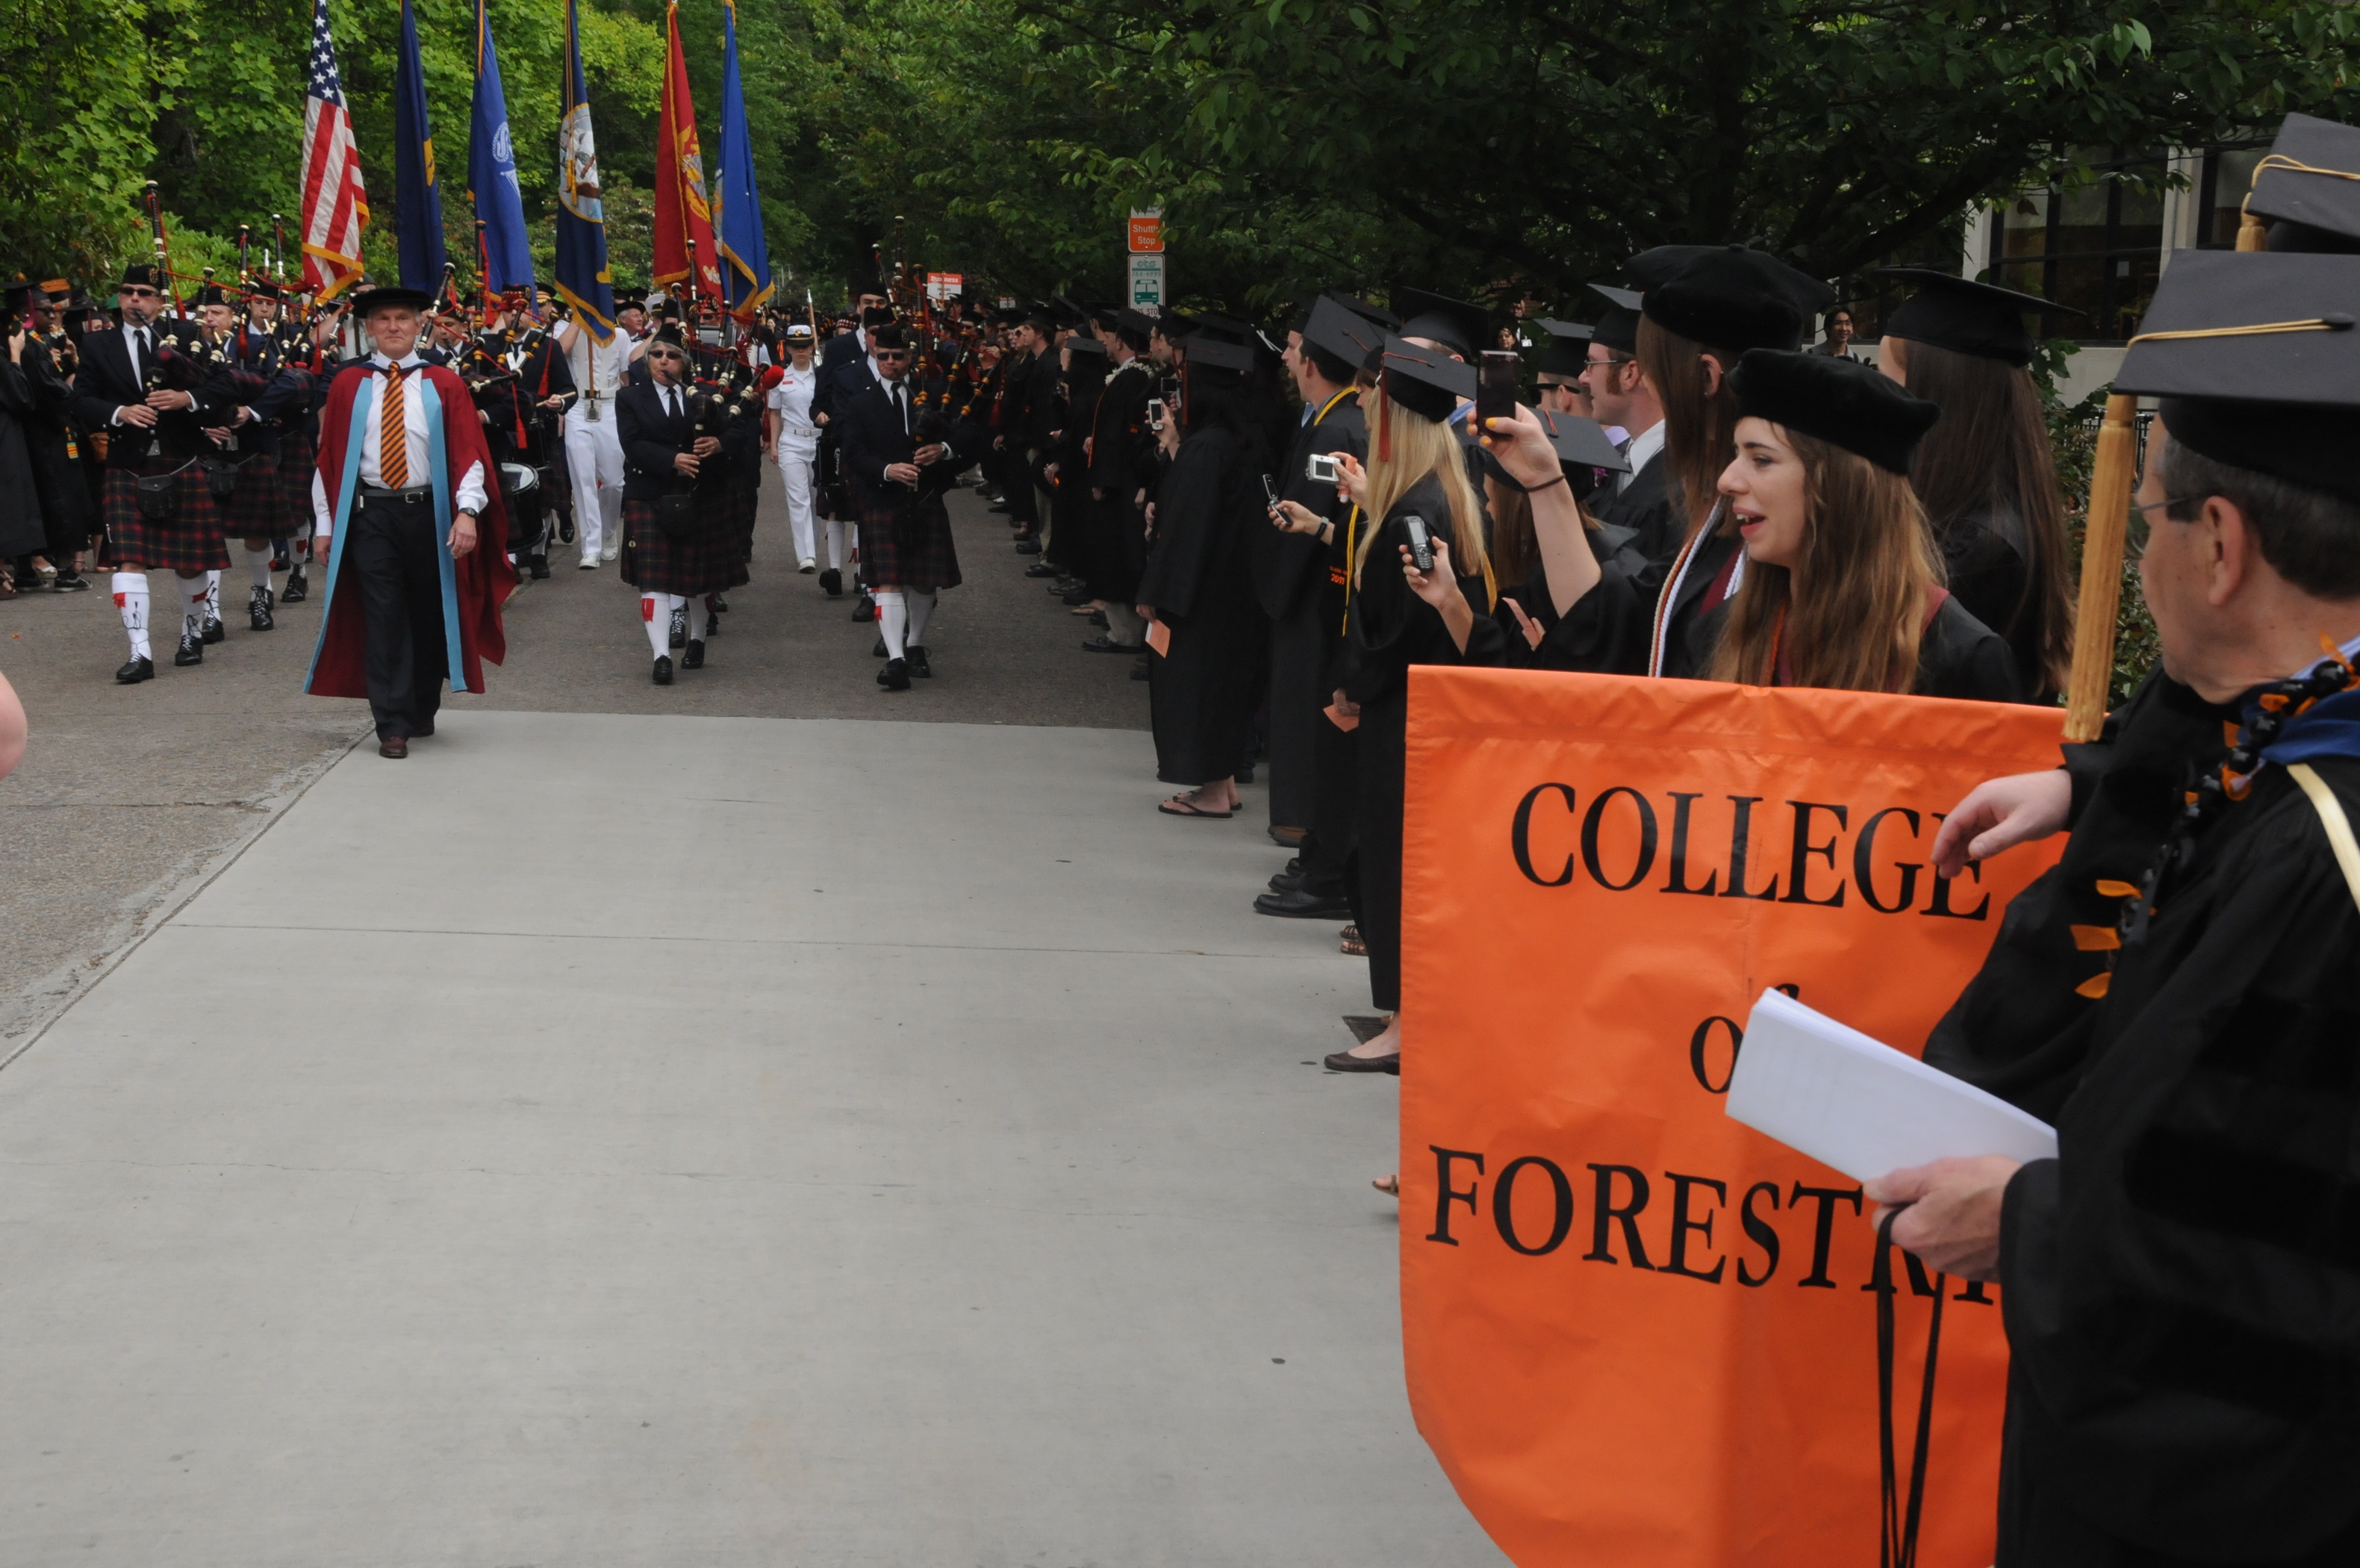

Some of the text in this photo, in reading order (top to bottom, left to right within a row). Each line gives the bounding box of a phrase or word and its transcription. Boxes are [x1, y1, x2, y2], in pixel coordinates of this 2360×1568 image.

[1138, 236, 1156, 246] Stop
[1330, 573, 1345, 585] 2011
[1511, 782, 1990, 921] COLLEGE
